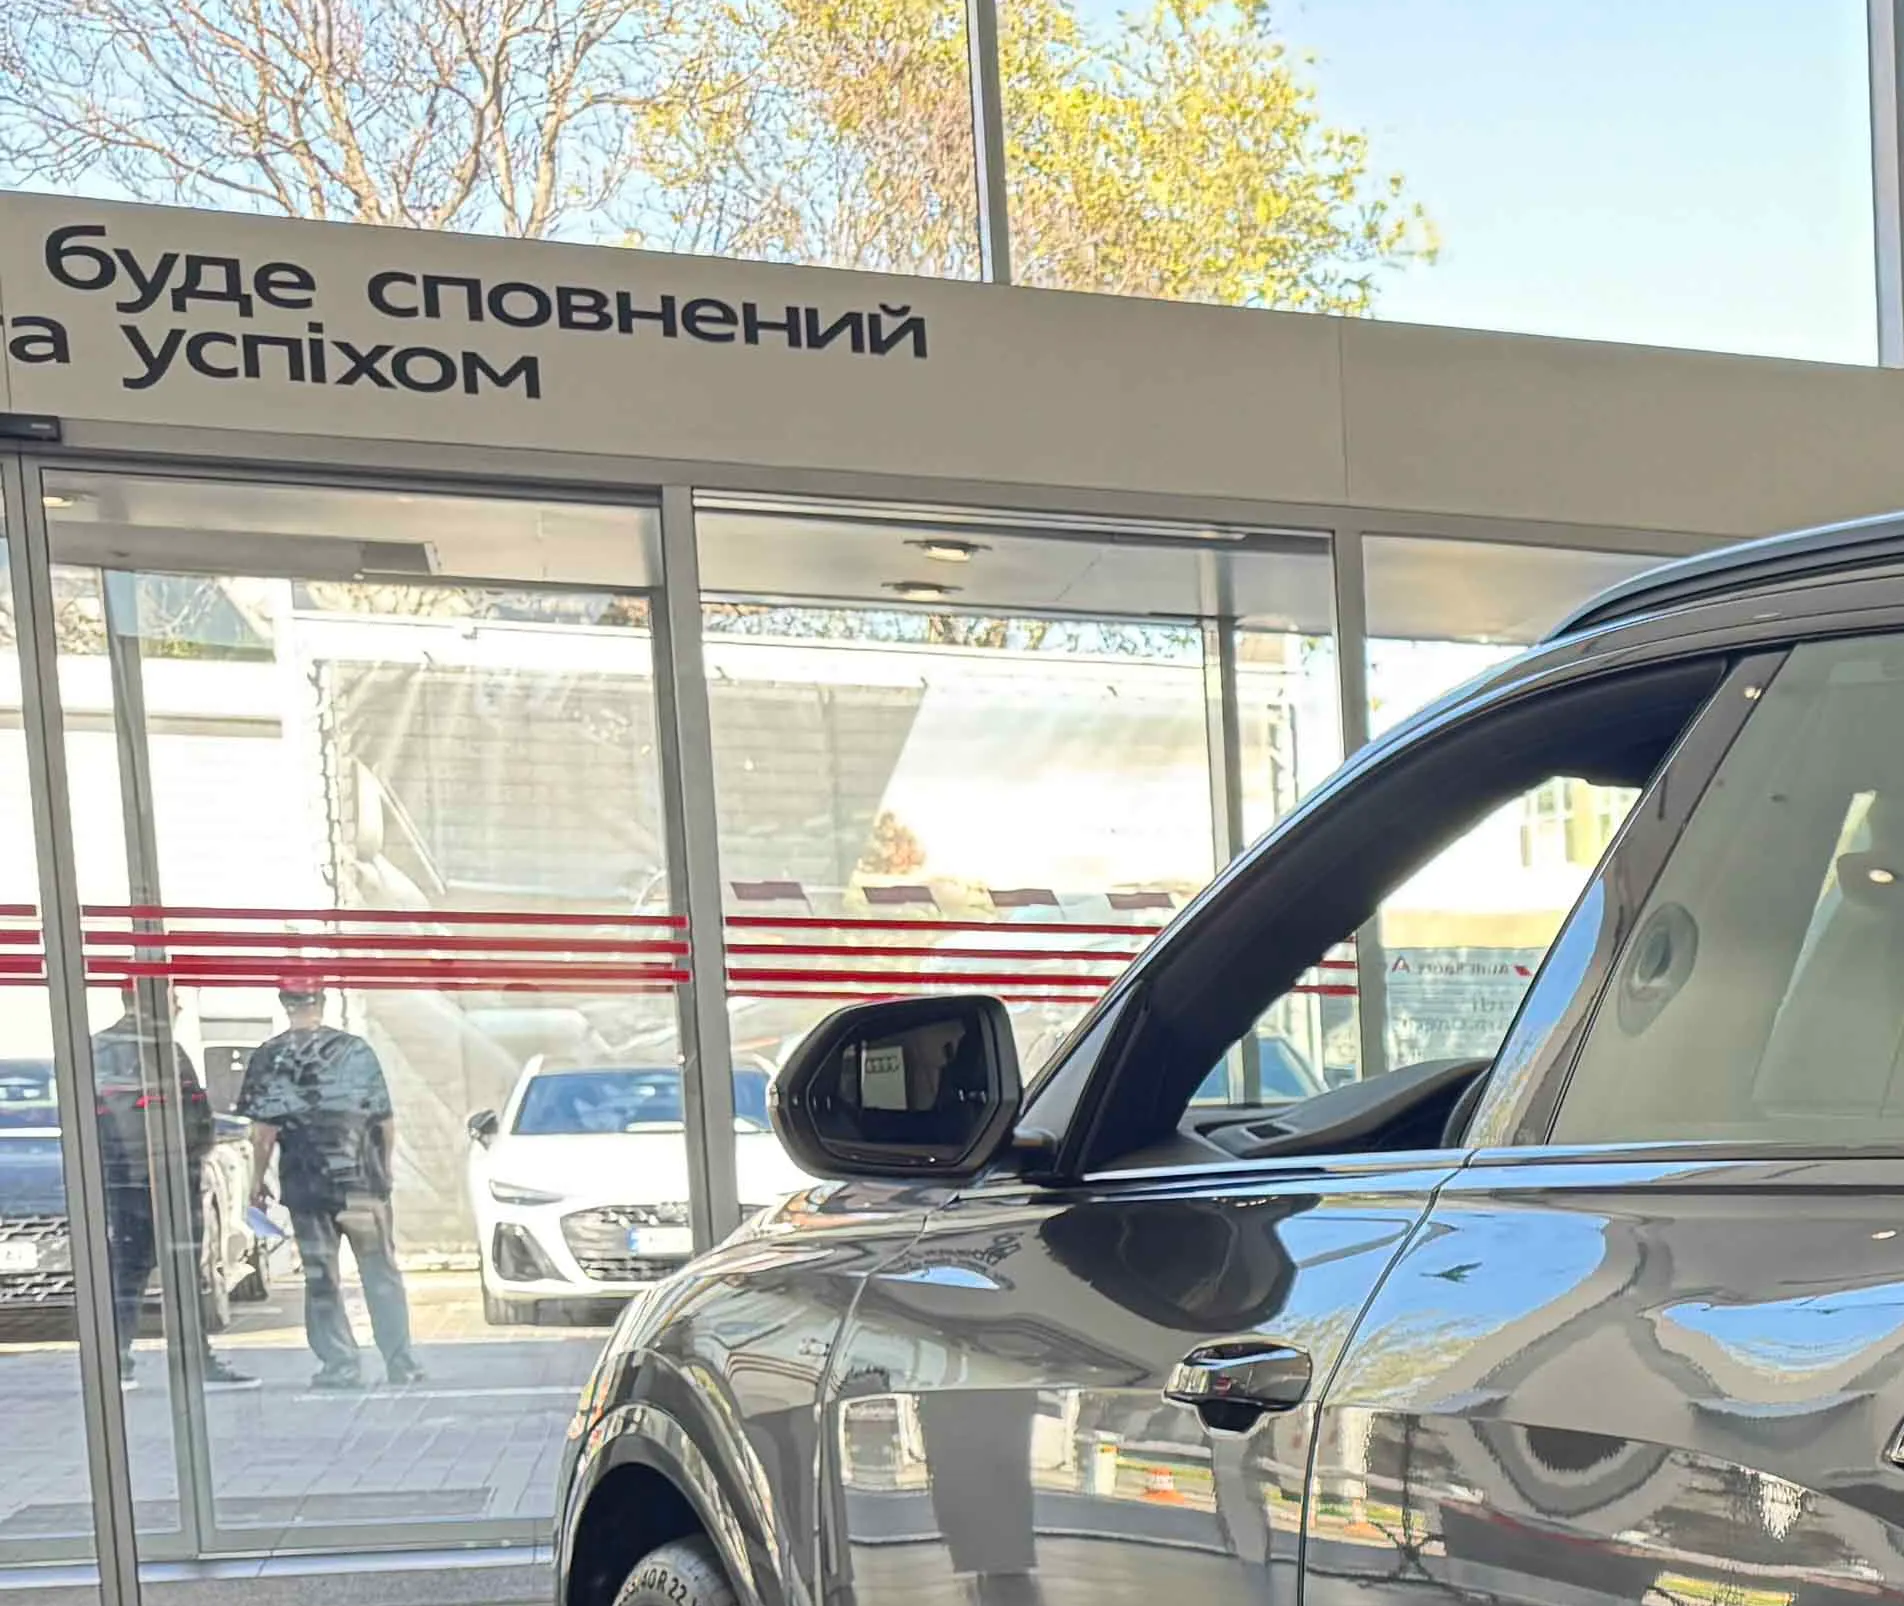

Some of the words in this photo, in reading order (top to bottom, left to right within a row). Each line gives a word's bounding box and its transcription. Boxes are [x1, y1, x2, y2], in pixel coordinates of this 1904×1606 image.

[45, 224, 317, 319] буде
[367, 271, 928, 359] сповнений
[0, 315, 70, 364] а
[119, 322, 541, 400] успіхом
